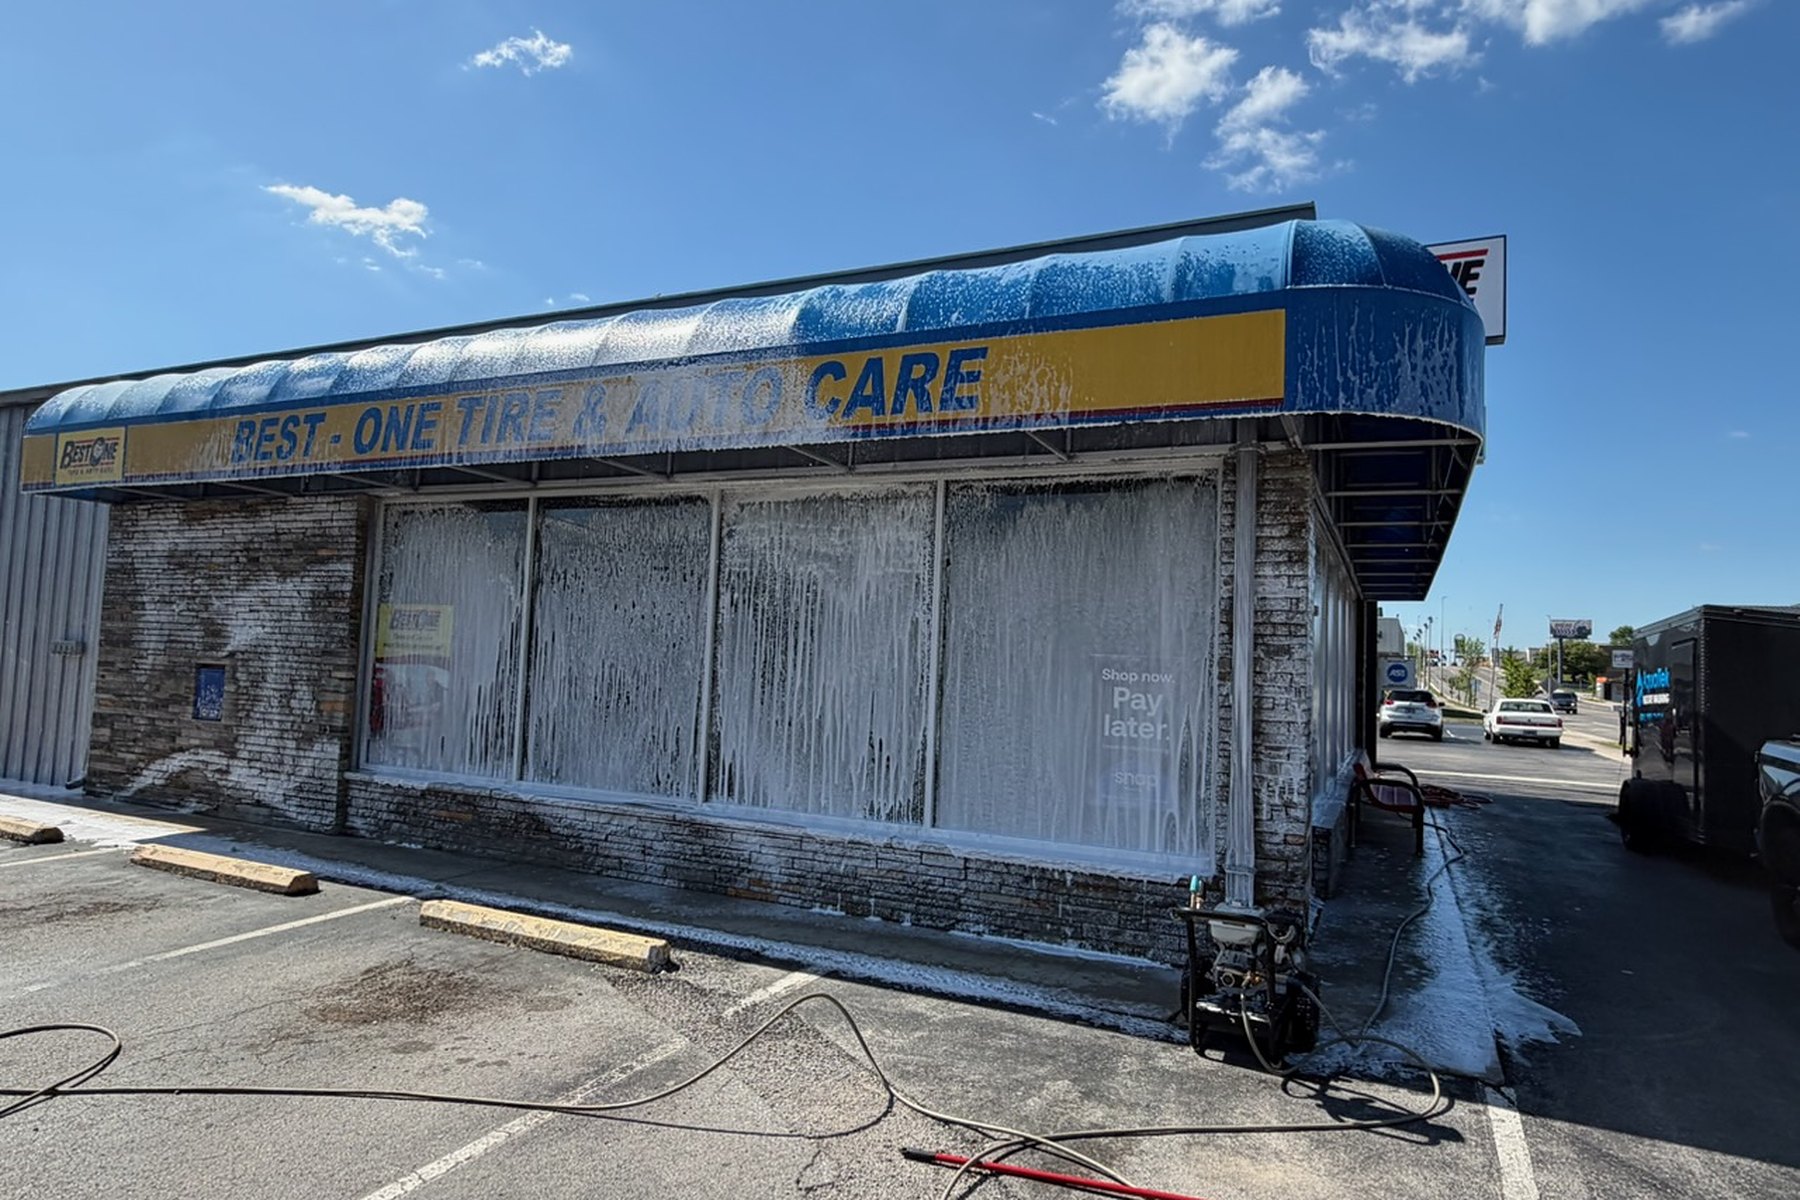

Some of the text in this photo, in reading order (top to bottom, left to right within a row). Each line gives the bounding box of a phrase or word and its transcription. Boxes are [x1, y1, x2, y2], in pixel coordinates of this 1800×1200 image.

[231, 412, 327, 463] BEST
[353, 402, 442, 454] ONE
[457, 389, 564, 445] TIRE
[573, 383, 607, 439] &
[625, 366, 783, 434] AUTO
[804, 347, 989, 420] CARE
[1102, 668, 1176, 684] Shop now.
[1113, 686, 1163, 716] Pay
[1104, 714, 1170, 740] later.
